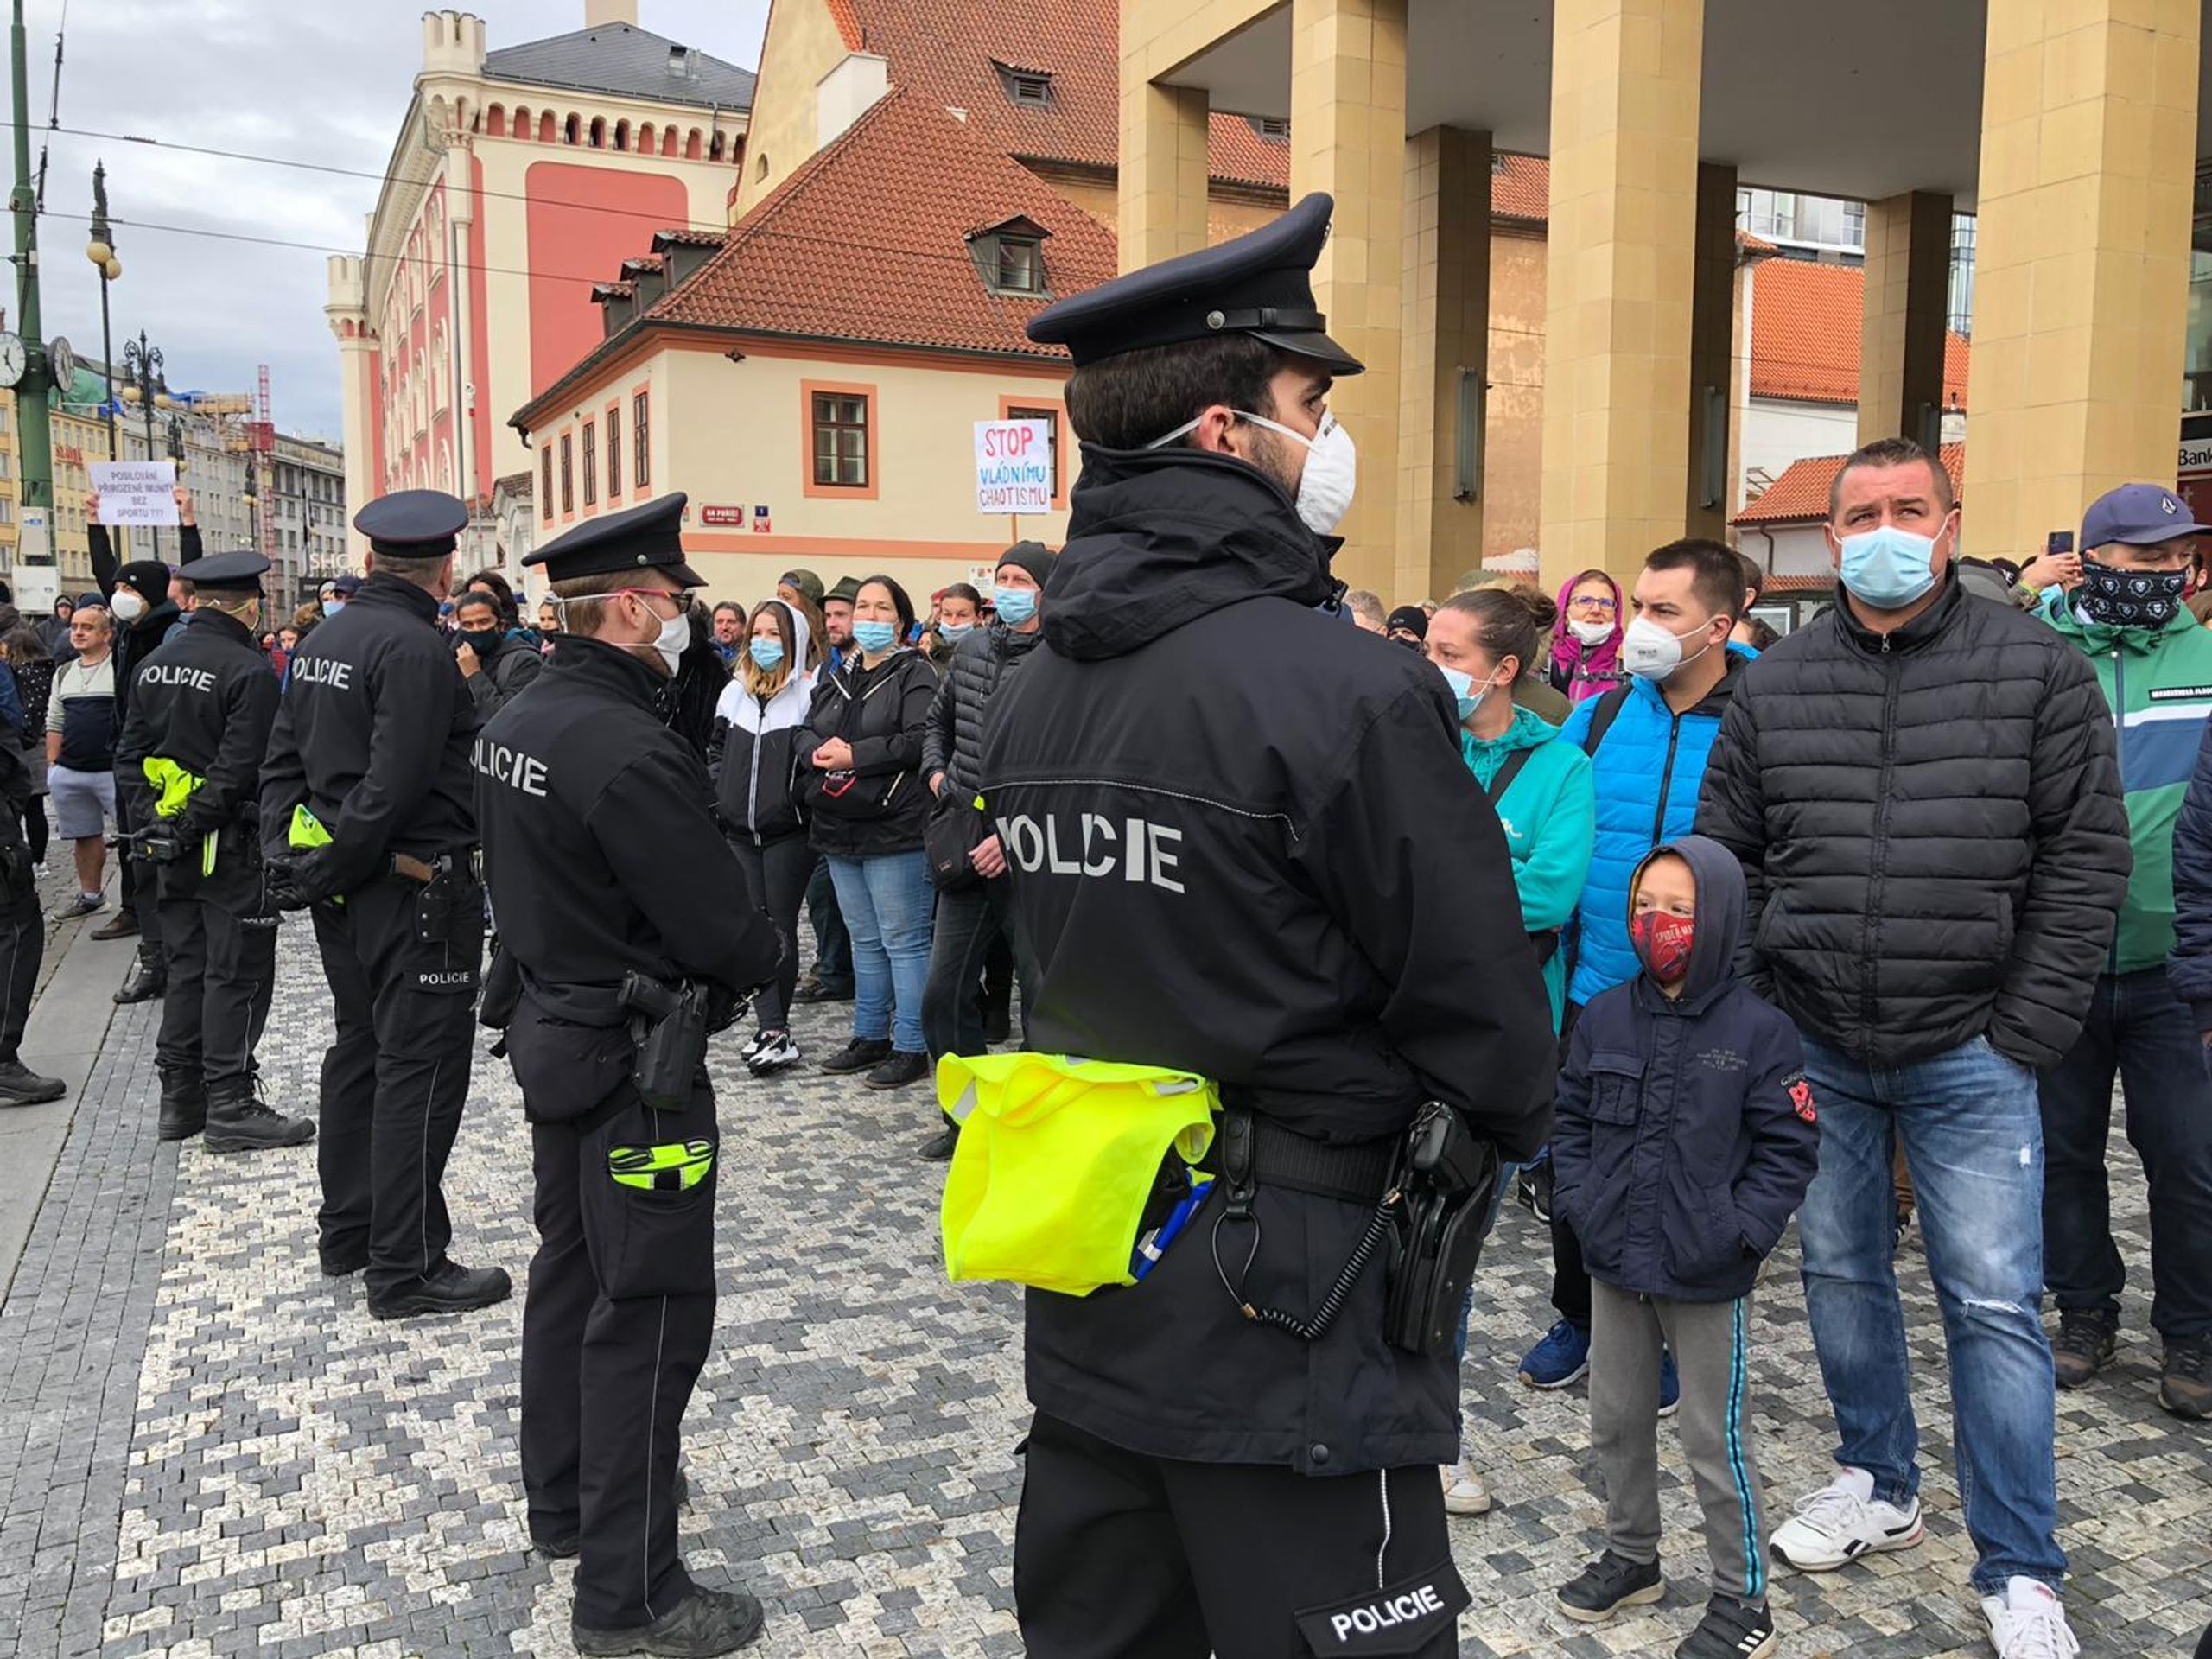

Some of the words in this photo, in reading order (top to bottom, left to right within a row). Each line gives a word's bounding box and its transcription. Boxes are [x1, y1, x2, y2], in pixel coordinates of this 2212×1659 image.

[985, 426, 1033, 458] STOP
[980, 460, 1046, 485] VLÁDNÍMU
[978, 486, 1048, 507] CHAOTISMU
[419, 971, 470, 985] POLICIE
[1331, 1585, 1445, 1642] POLICIE
